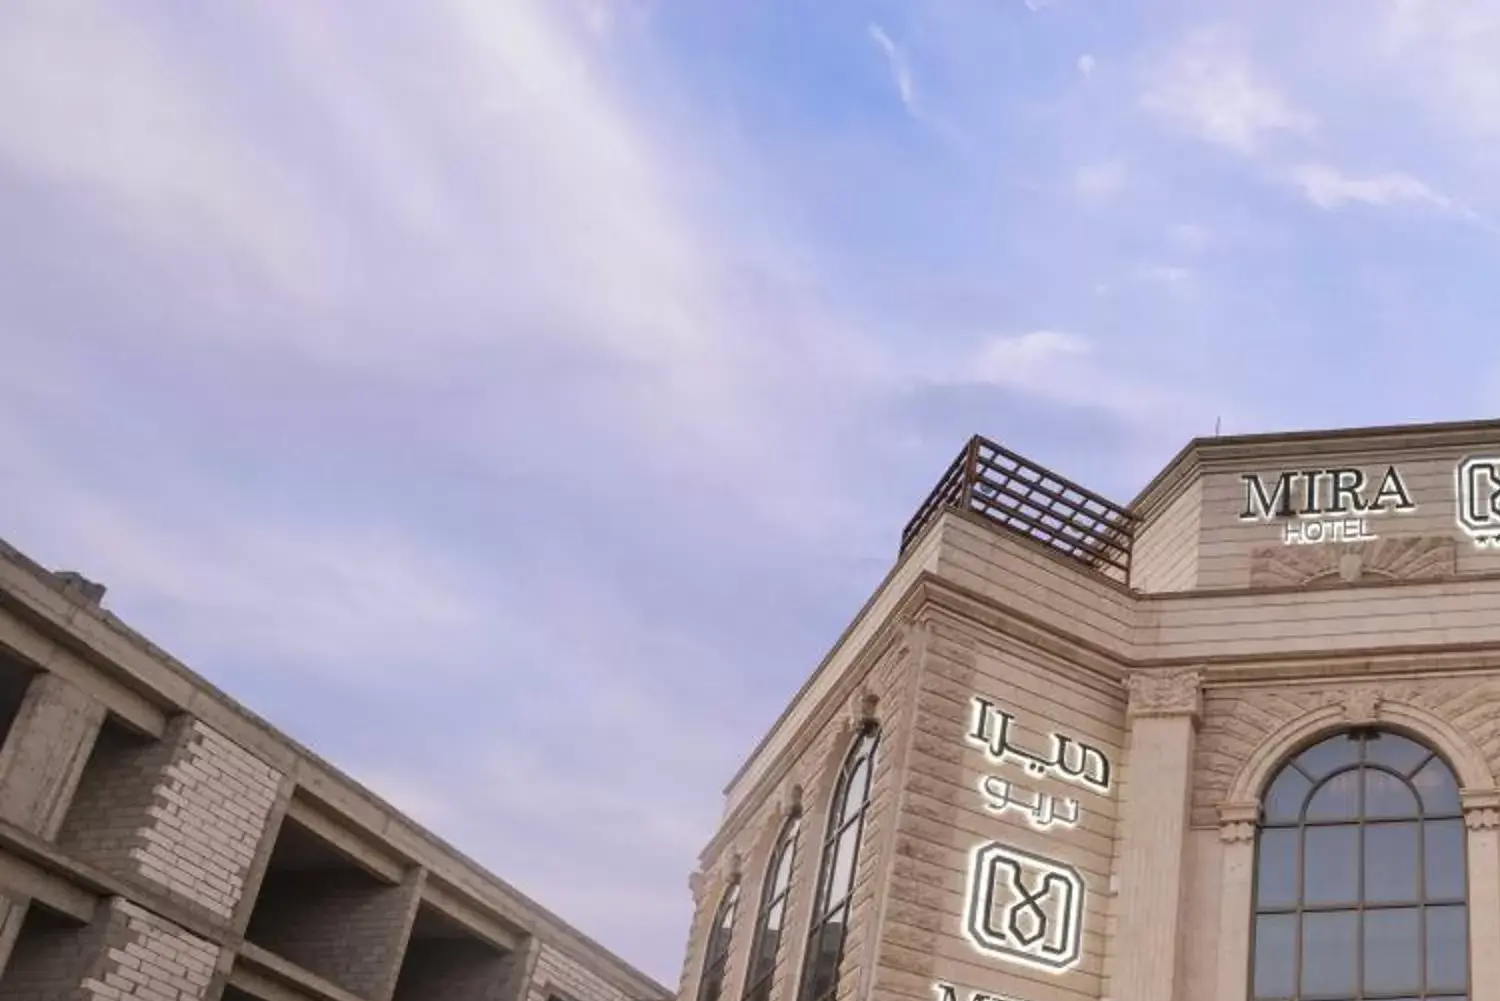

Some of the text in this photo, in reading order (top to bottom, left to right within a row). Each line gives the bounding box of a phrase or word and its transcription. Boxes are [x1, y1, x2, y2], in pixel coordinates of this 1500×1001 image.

[1239, 464, 1415, 519] MIRA
[1284, 518, 1378, 545] HOTEL
[968, 696, 1110, 789] ميرا
